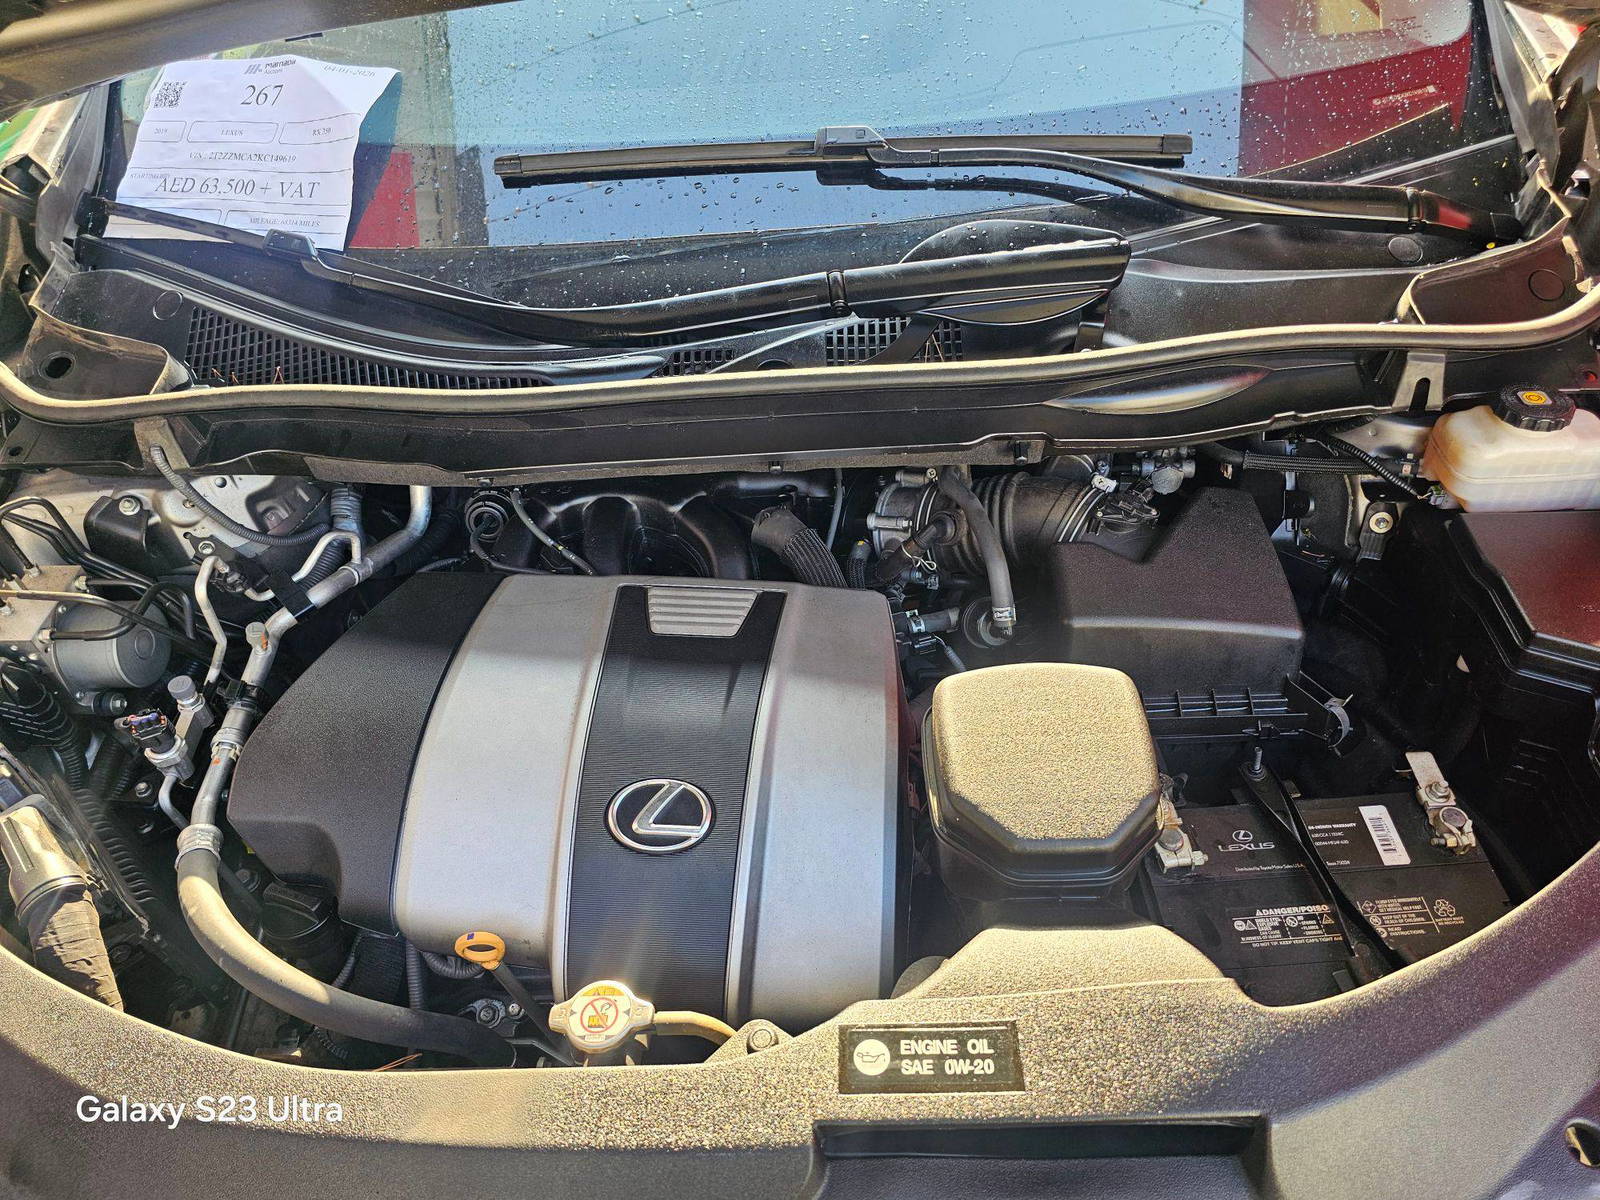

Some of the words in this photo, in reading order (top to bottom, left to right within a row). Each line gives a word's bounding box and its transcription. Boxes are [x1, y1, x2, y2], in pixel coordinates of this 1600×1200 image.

[240, 84, 284, 106] 267
[155, 177, 196, 193] AED
[280, 181, 321, 198] VAT
[1218, 842, 1275, 852] LEXUS
[900, 1039, 958, 1055] ENGINE
[967, 1038, 995, 1055] OIL
[901, 1059, 935, 1075] SAE
[944, 1058, 995, 1075] 0W-20
